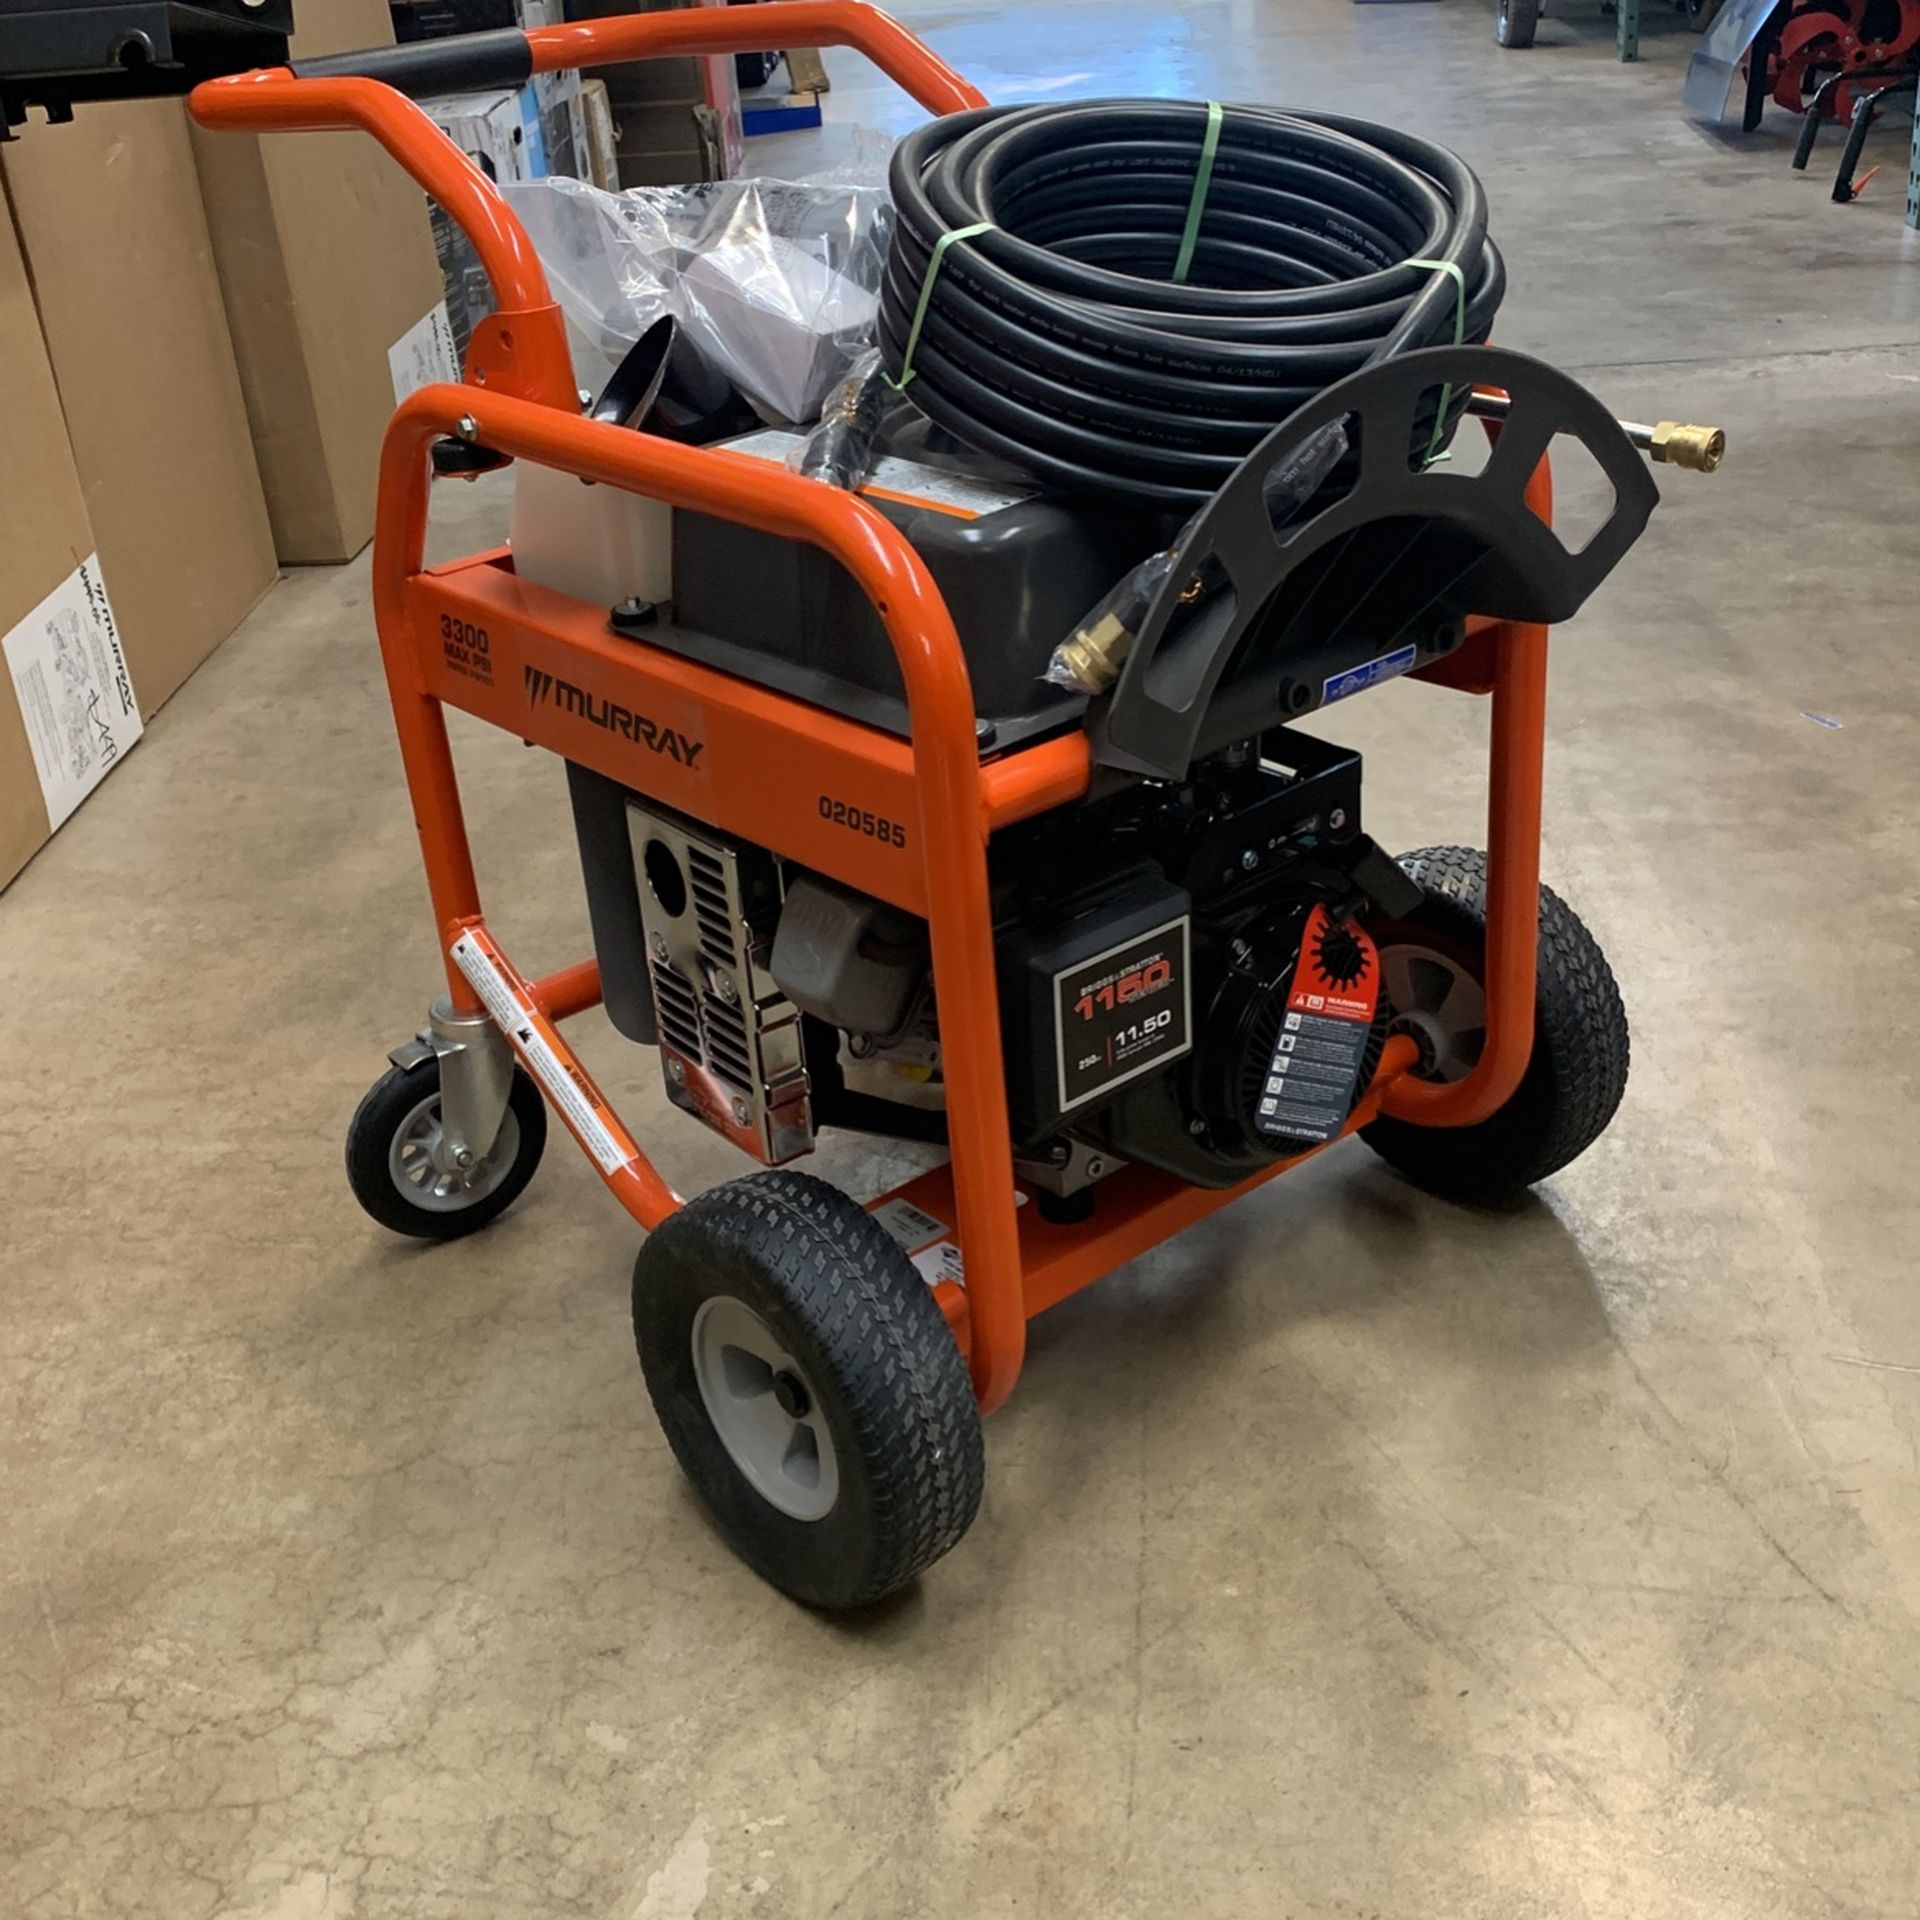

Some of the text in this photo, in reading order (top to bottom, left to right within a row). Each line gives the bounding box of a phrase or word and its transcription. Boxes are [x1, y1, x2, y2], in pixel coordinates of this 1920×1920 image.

[102, 606, 135, 710] MURRAY
[441, 613, 489, 654] 3300
[444, 641, 471, 665] MAX
[473, 653, 492, 674] PSI
[555, 678, 704, 771] MURRAY
[818, 795, 906, 849] 020585
[1074, 960, 1171, 1021] 1150
[1115, 1009, 1172, 1046] 11.50
